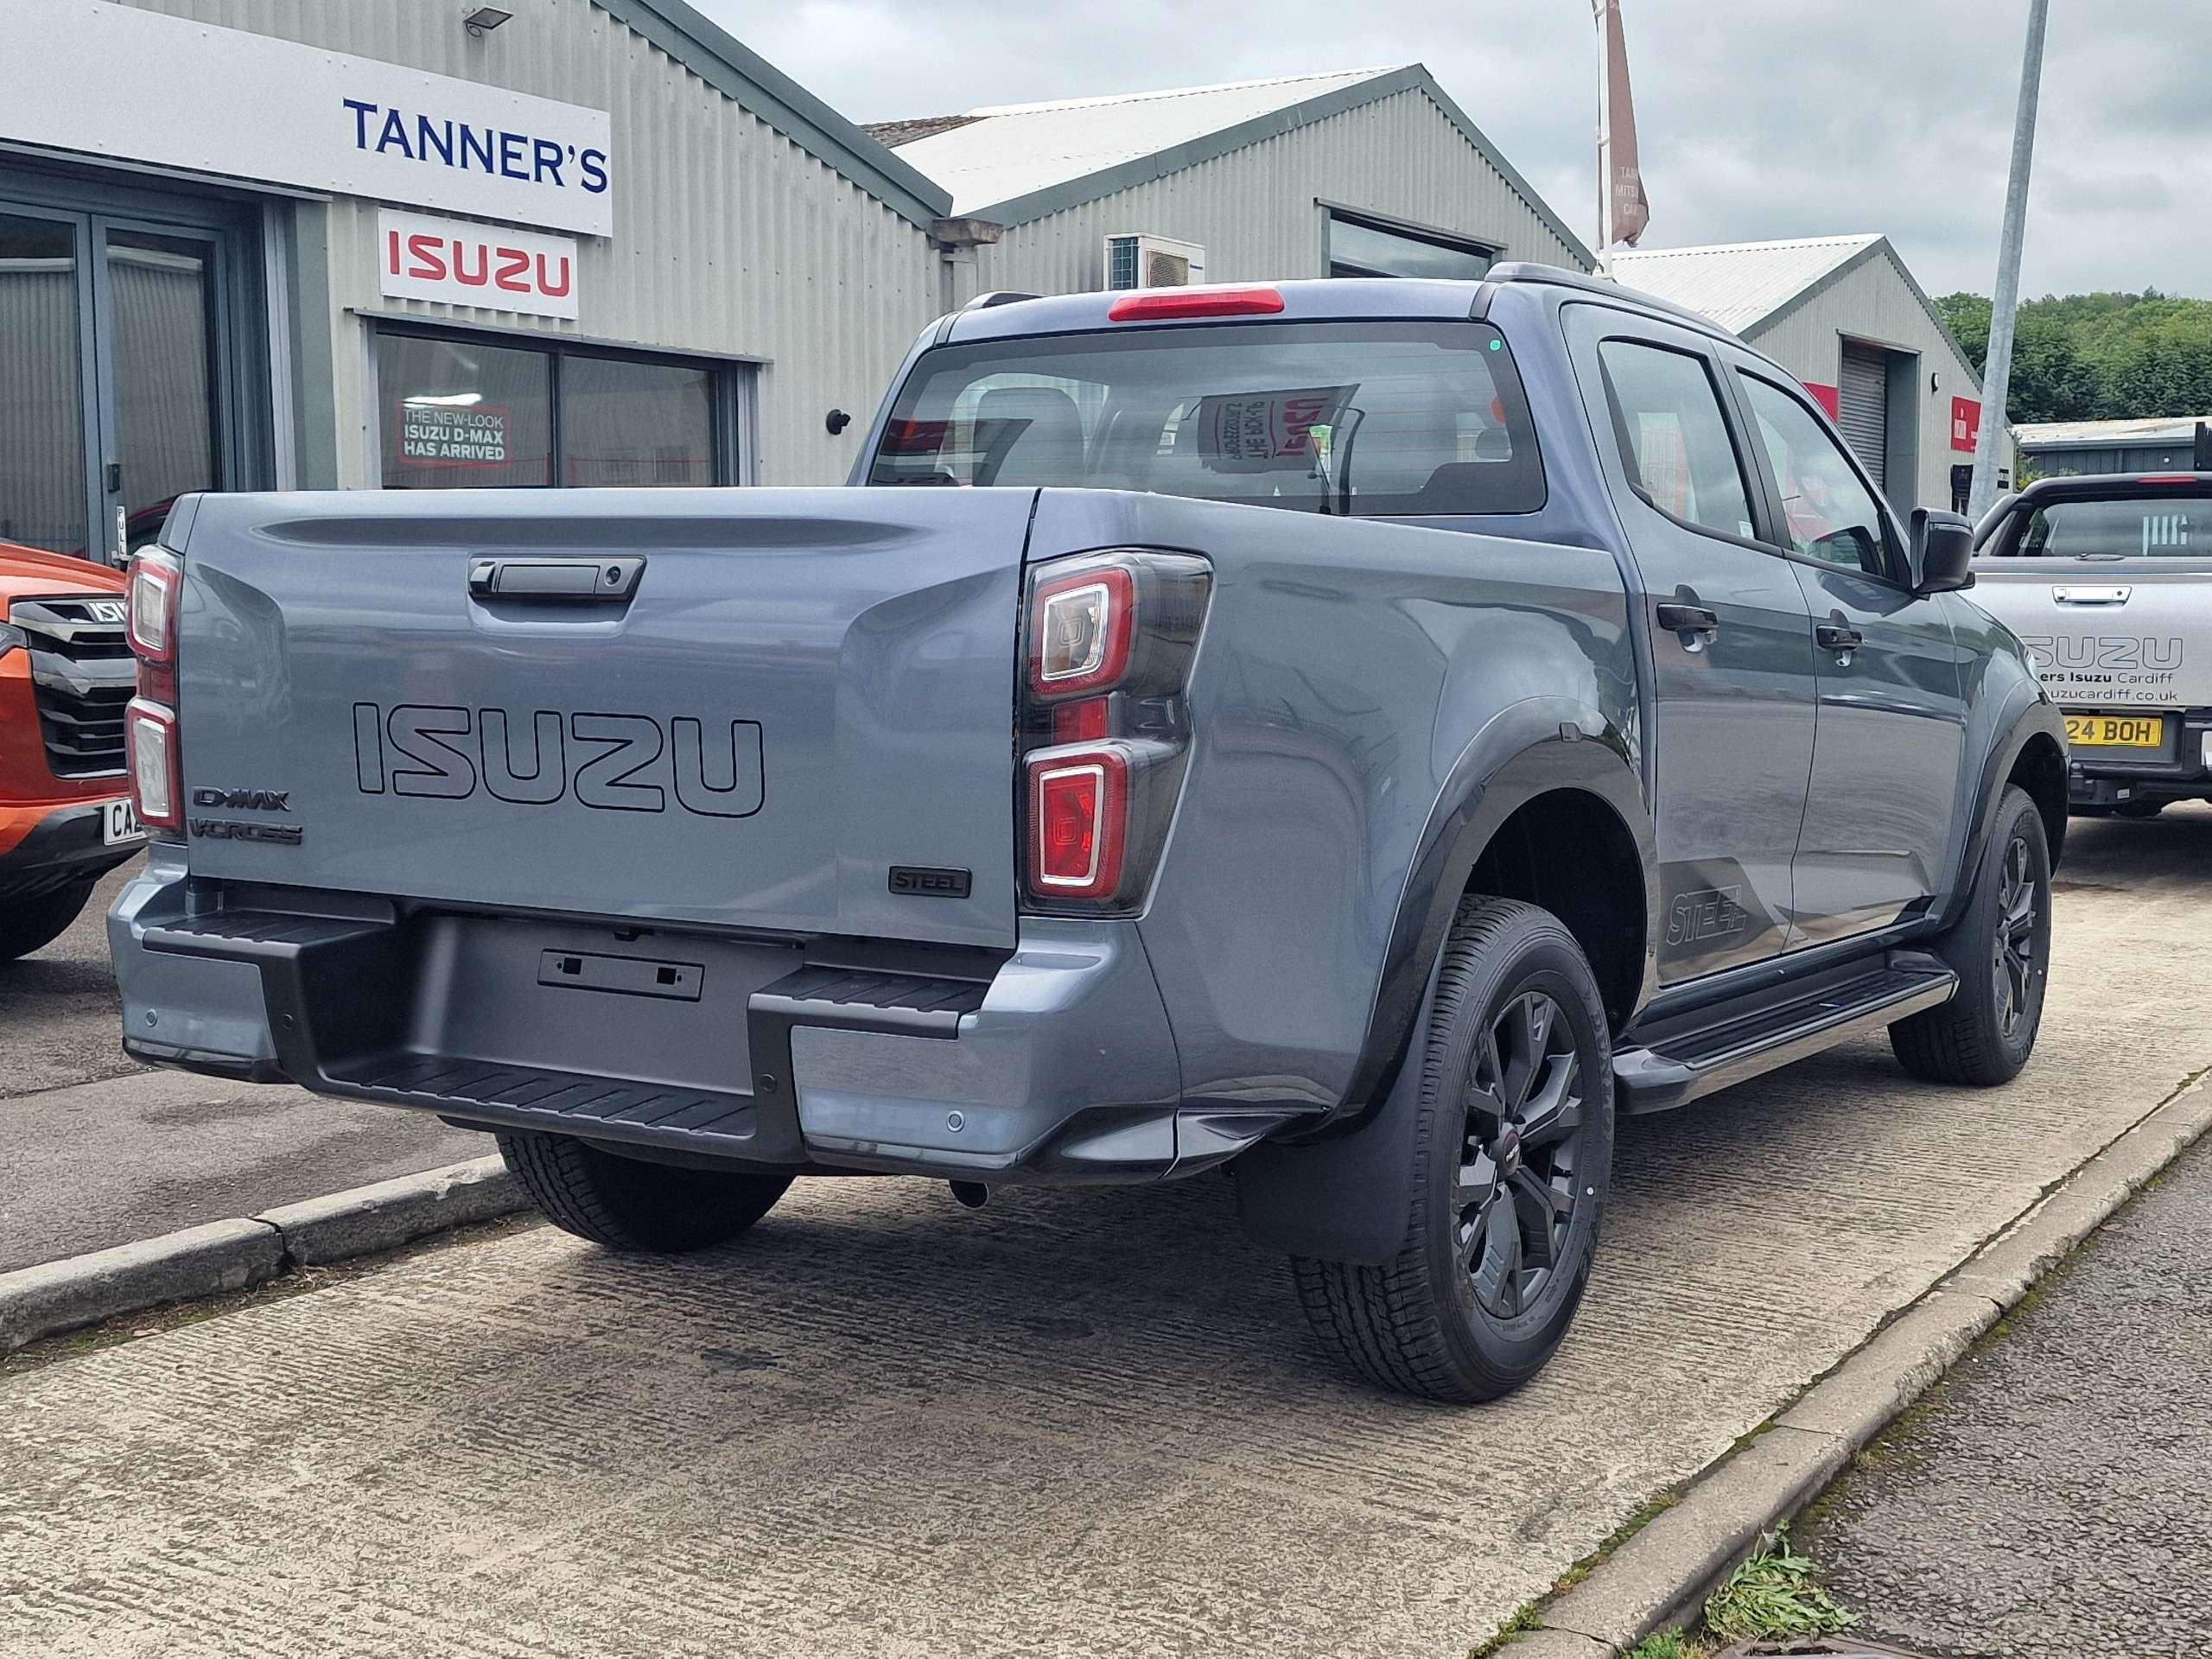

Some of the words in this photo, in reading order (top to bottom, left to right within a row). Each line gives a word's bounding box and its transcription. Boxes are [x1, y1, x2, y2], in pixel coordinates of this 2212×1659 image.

[343, 97, 608, 194] TANNER'S
[389, 231, 570, 297] ISUZU
[404, 409, 431, 423] THE
[434, 412, 504, 429] NEW-LOOK
[404, 424, 450, 441] ISUZU
[454, 428, 504, 445] D-MAX
[404, 442, 436, 457] HAS
[440, 443, 505, 461] ARRIVED
[2070, 672, 2112, 683] Isuzu
[2117, 671, 2174, 684] Cardiff
[2047, 689, 2178, 702] uzucardiff.co.uk
[2102, 721, 2152, 742] BOH
[353, 702, 766, 818] ISUZU
[112, 804, 143, 836] CA
[894, 870, 964, 891] STEEL
